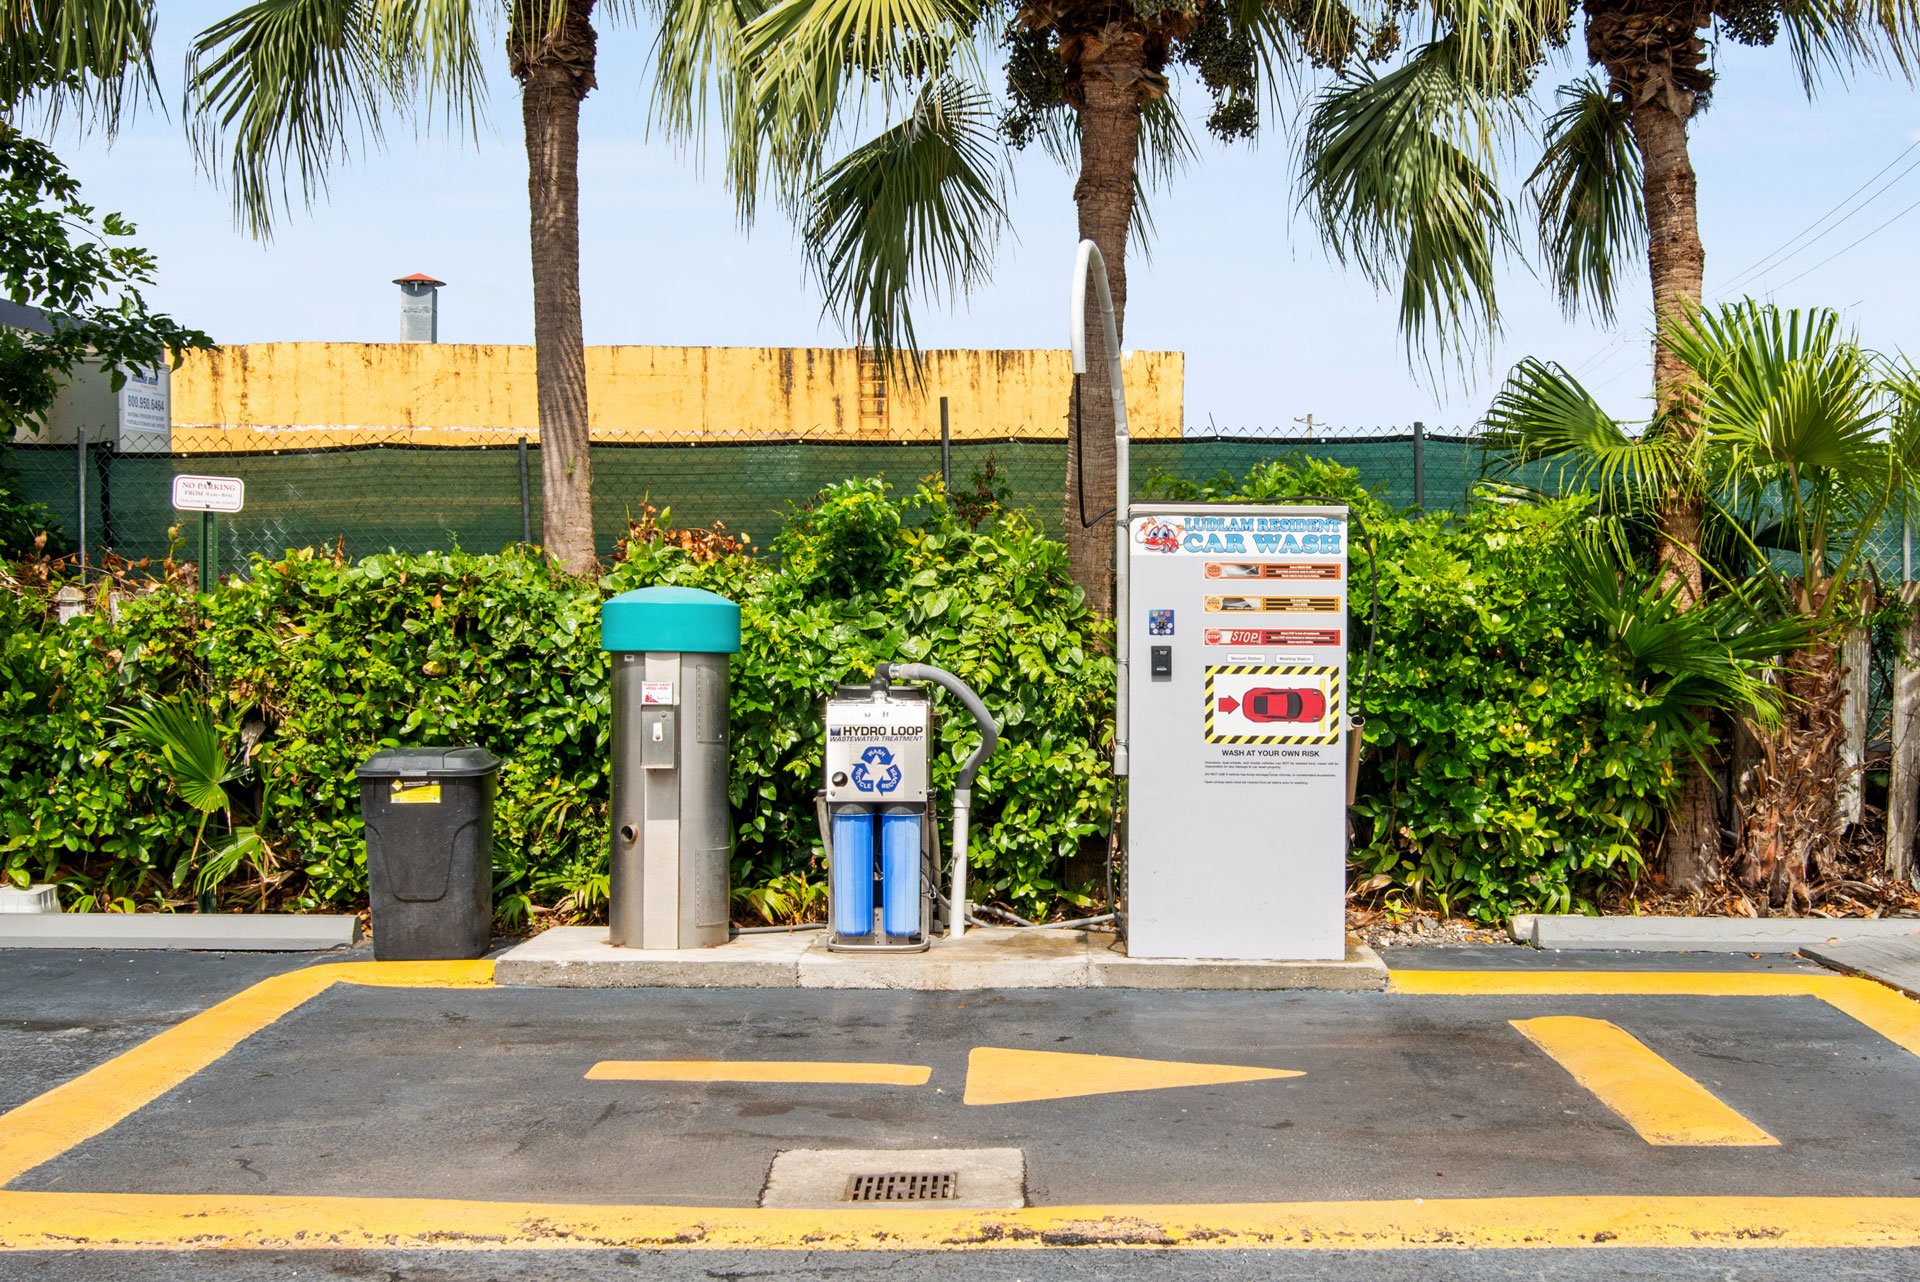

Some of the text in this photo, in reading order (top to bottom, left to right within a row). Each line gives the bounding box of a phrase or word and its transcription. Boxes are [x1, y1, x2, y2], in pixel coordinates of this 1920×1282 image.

[128, 395, 165, 412] 800.950.6464
[197, 482, 236, 491] PARKING
[1184, 518, 1342, 533] LUDLAM RESIDENT
[1183, 534, 1342, 555] CAR WASH
[844, 726, 923, 736] HYDRO LOOP
[867, 748, 886, 758] WASH
[856, 768, 872, 789] RECYCLE
